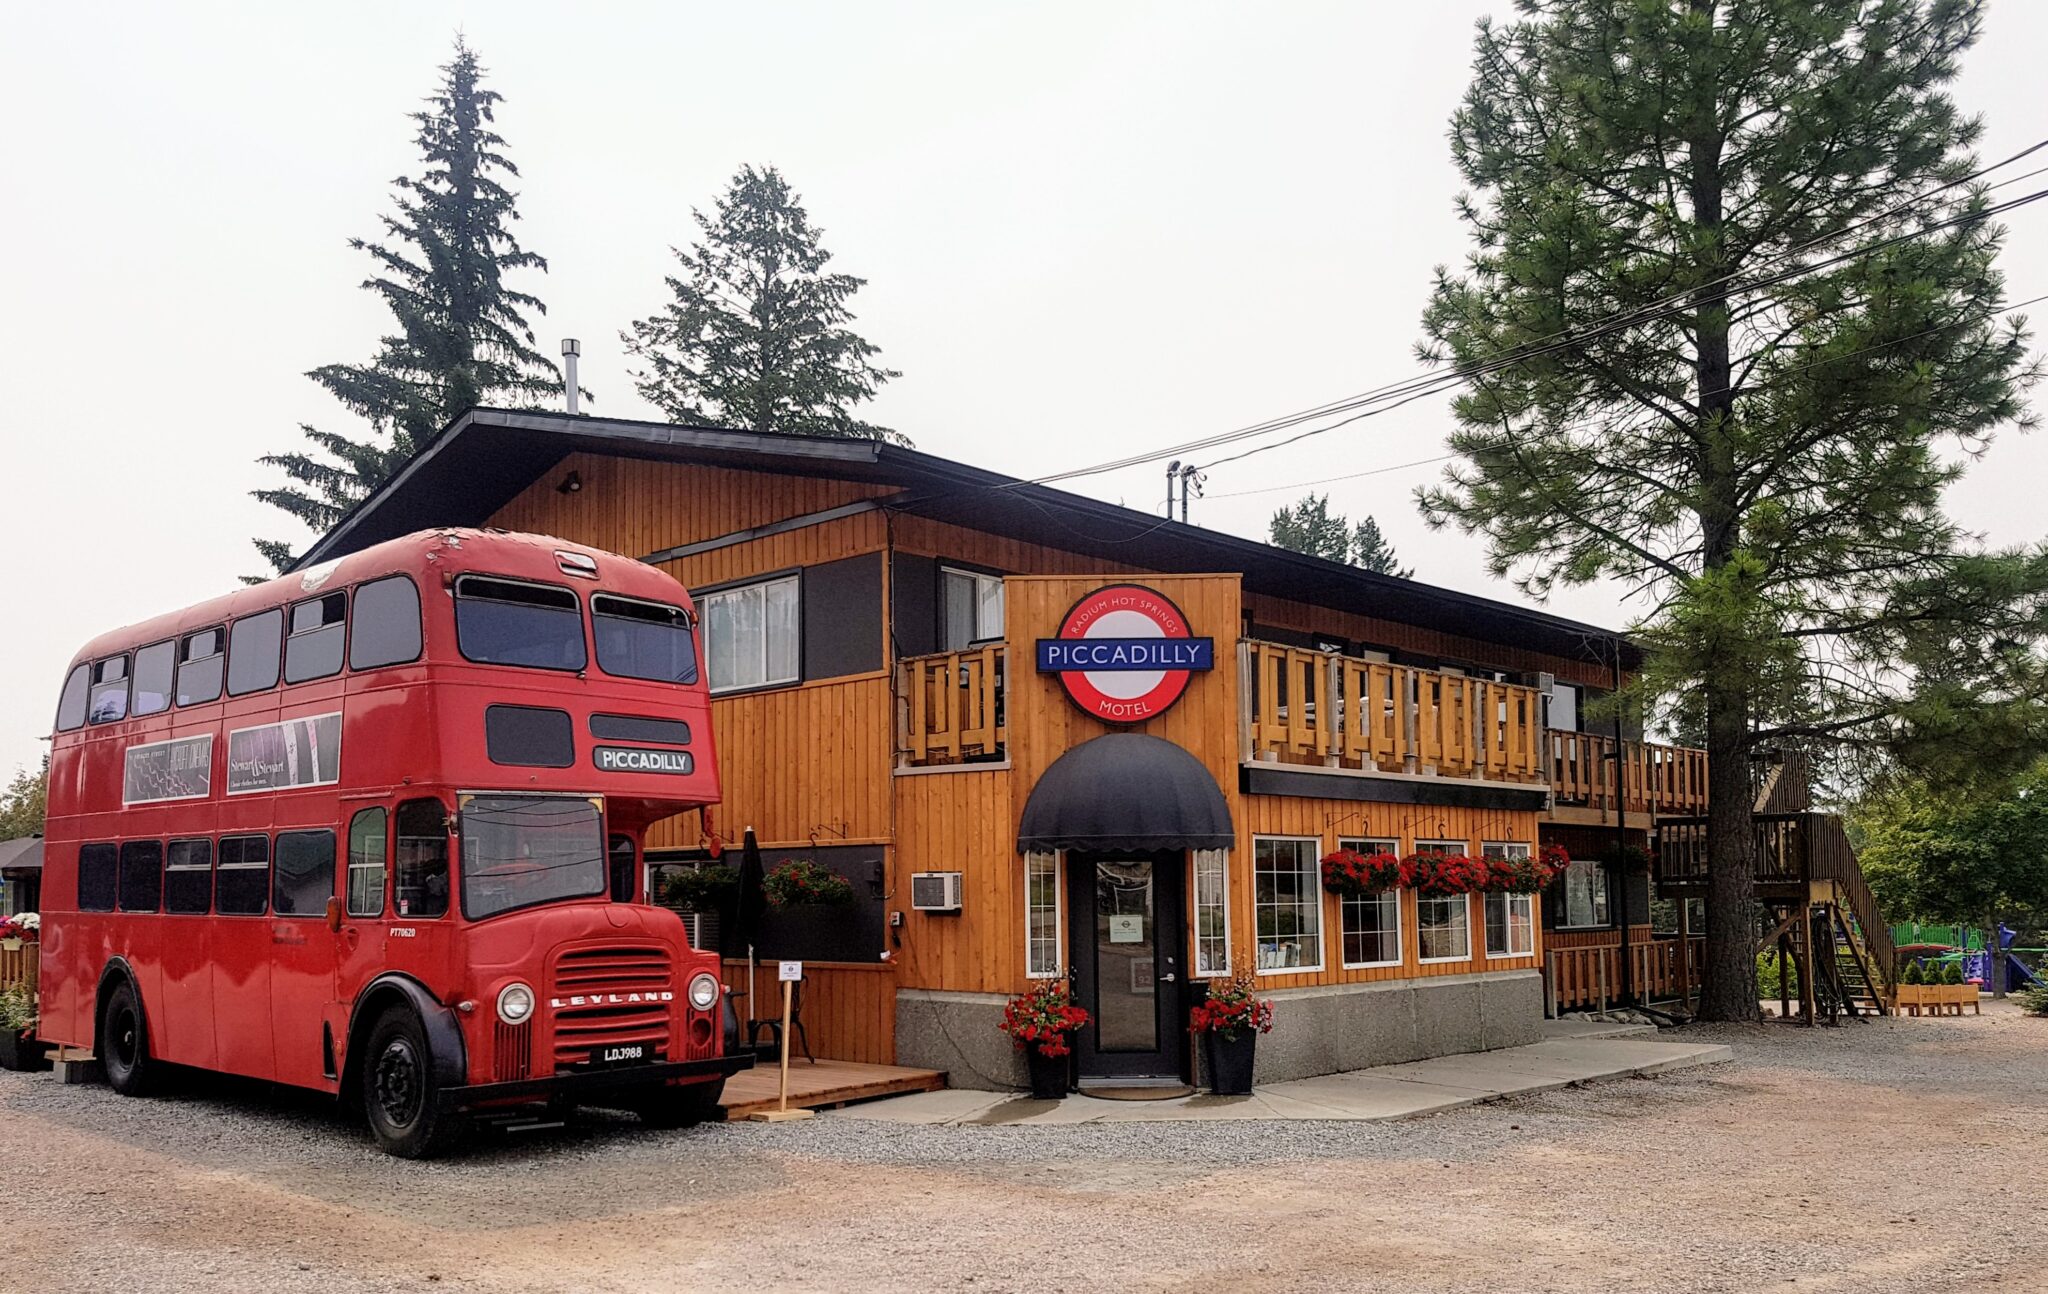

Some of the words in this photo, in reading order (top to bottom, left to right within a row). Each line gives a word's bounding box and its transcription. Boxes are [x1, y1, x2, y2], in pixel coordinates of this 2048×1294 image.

[1071, 601, 1108, 634] RADIUM
[1112, 597, 1136, 607] HOT
[1139, 600, 1178, 633] SPRINGS
[1048, 645, 1200, 665] PICCADILLY
[1099, 700, 1152, 716] MOTEL
[231, 759, 254, 773] Stewart
[260, 761, 284, 775] Stewart
[602, 751, 686, 771] PICCADILLY
[390, 927, 416, 937] PT70620
[551, 991, 673, 1008] LEYLAND
[604, 1046, 642, 1061] LDJ988
